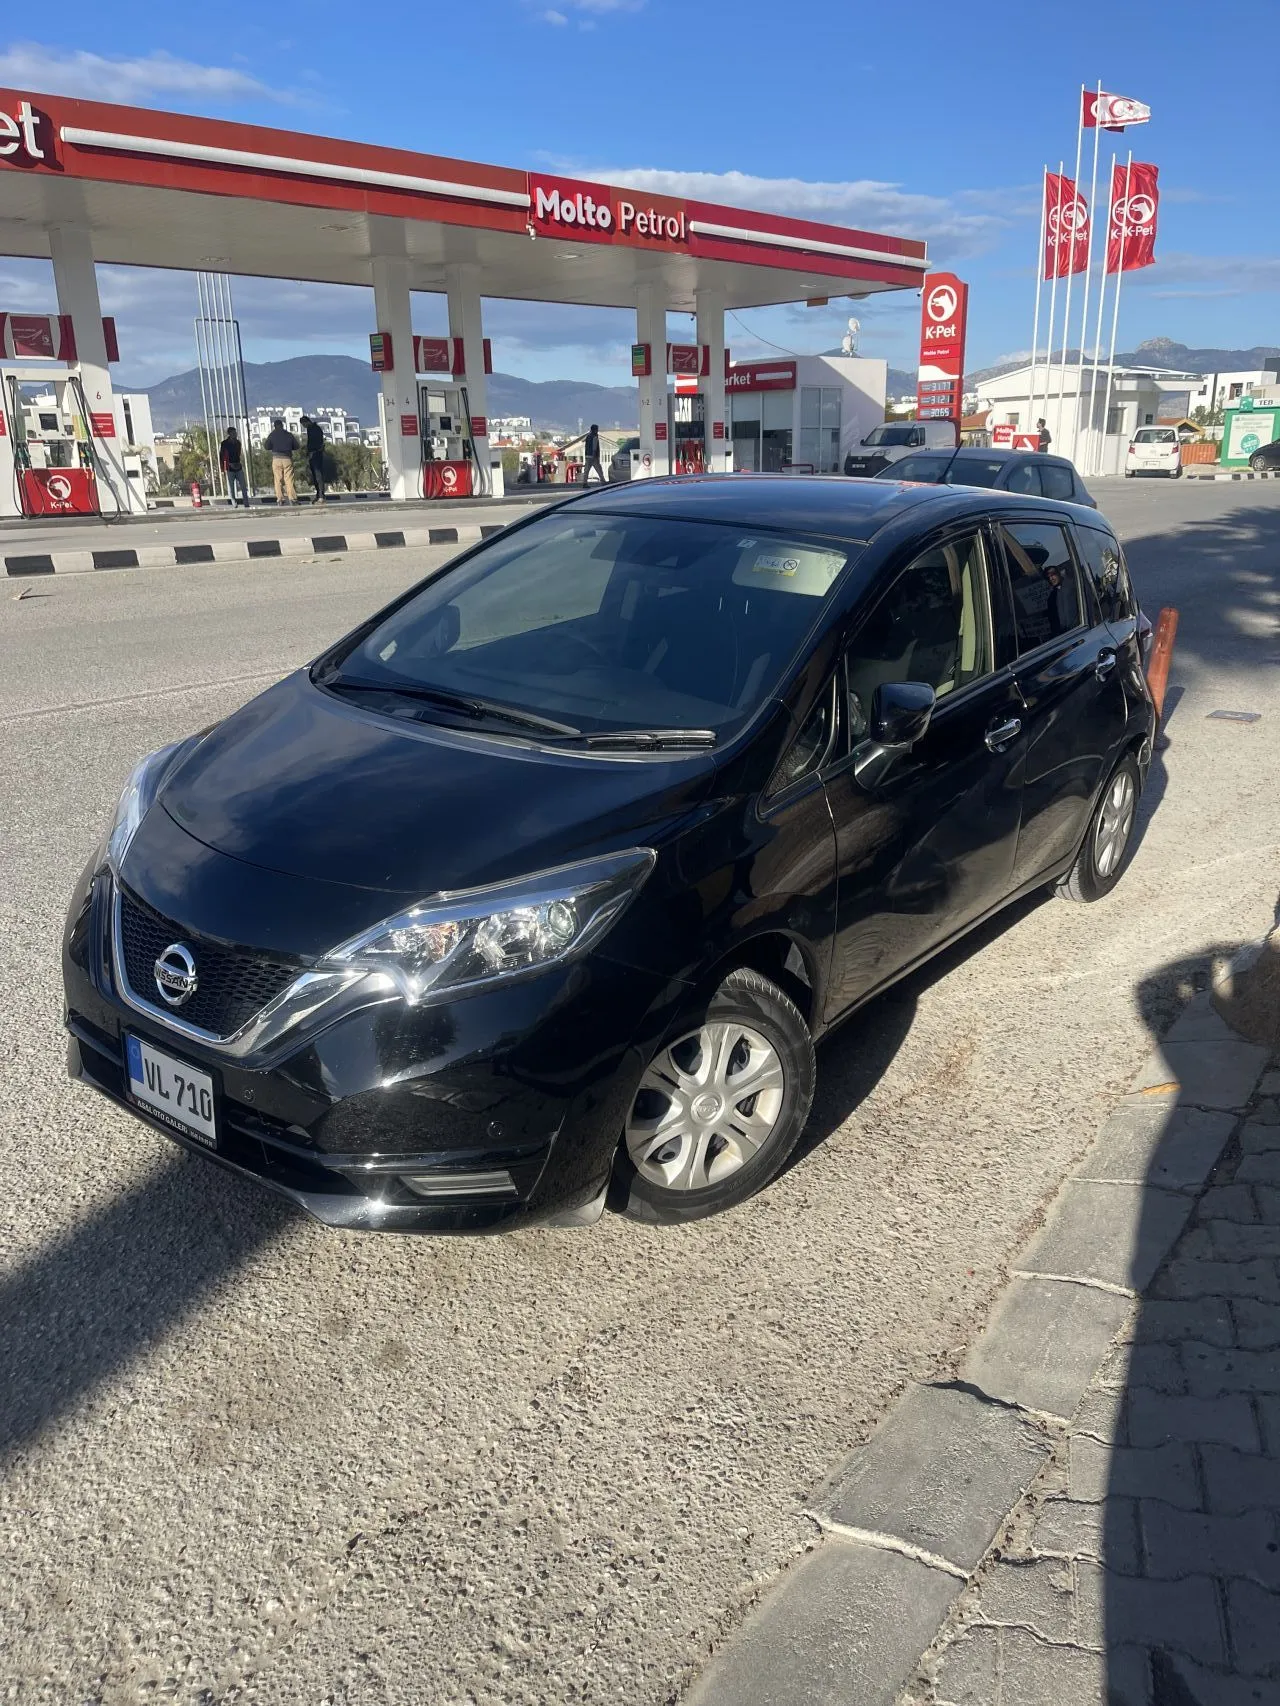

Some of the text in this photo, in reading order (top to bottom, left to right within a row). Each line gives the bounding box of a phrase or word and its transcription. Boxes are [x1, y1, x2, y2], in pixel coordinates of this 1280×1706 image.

[535, 187, 685, 239] Molto Petrol
[1124, 225, 1154, 237] K-Pet
[925, 323, 957, 339] K-Pet
[96, 392, 101, 400] 6
[155, 964, 189, 989] NISSAN
[144, 1058, 212, 1122] VL 710
